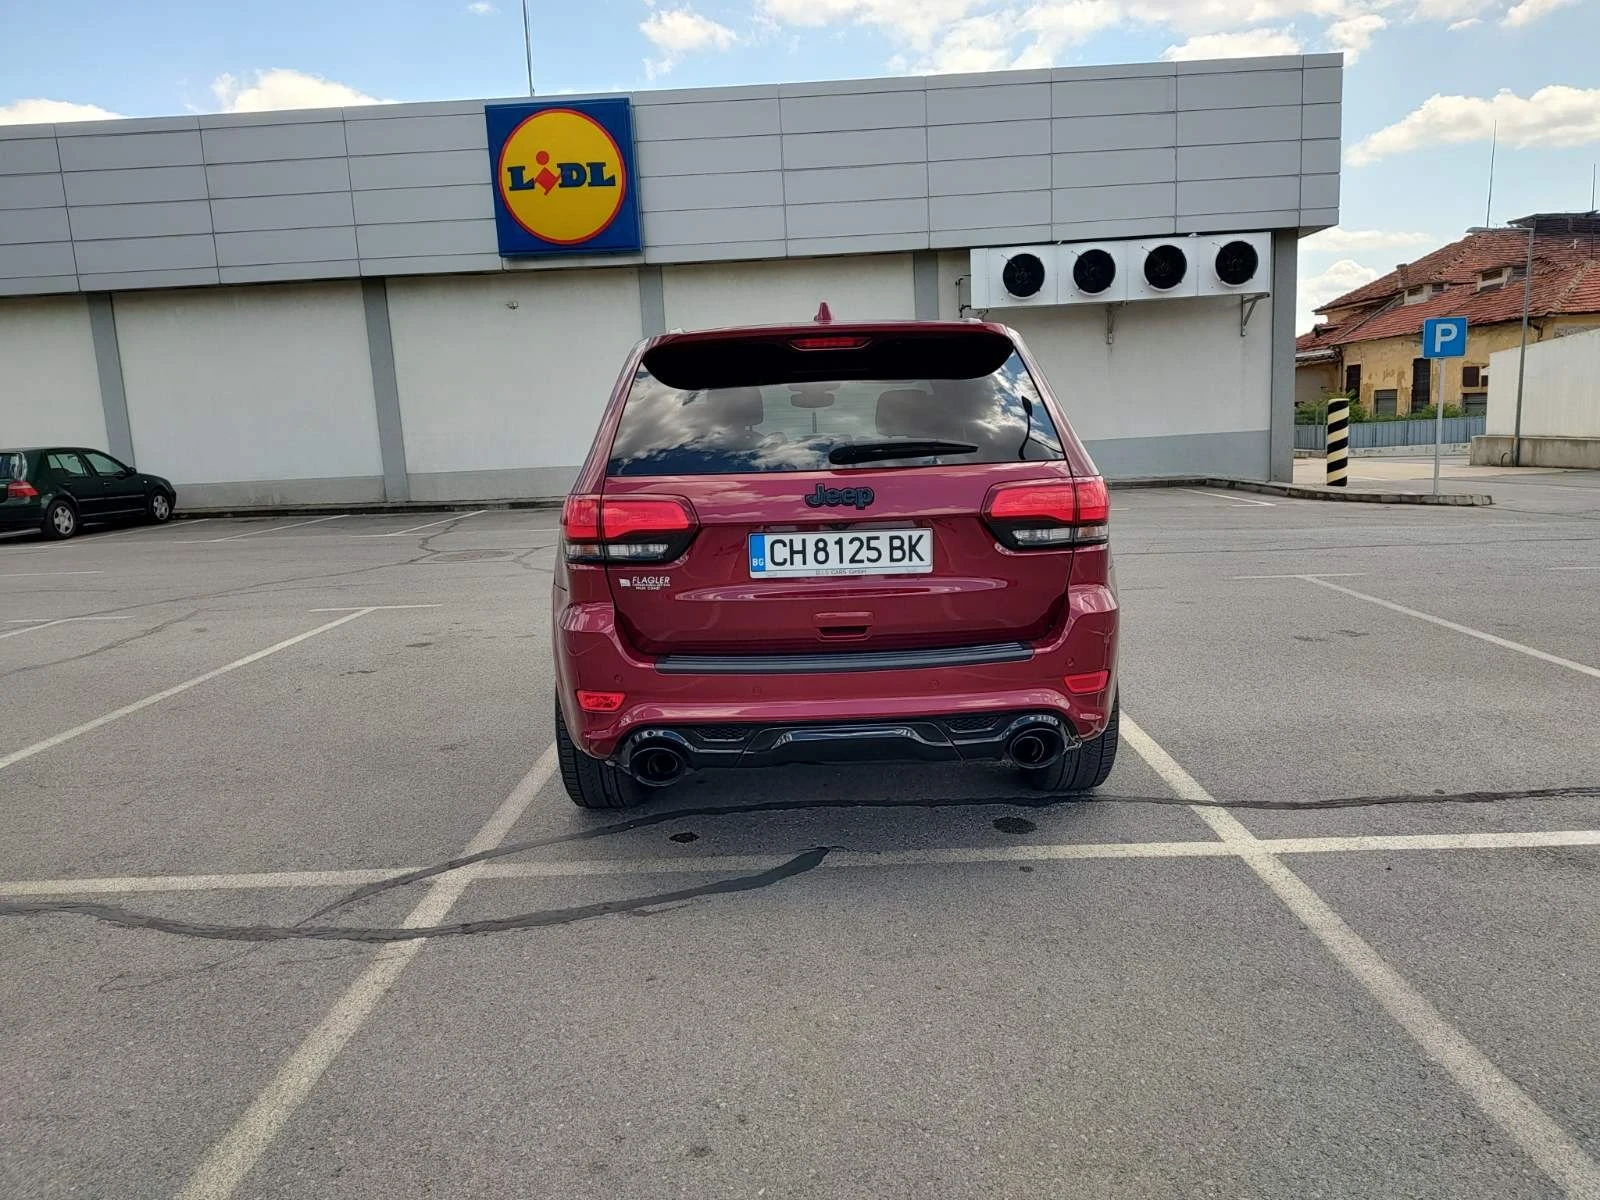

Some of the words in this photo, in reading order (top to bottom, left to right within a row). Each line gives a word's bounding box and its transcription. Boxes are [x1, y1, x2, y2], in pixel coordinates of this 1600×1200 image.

[1435, 323, 1457, 352] P
[805, 483, 874, 510] Jeep
[752, 558, 764, 566] BG
[770, 538, 807, 566] CH
[813, 536, 882, 564] 8125
[889, 534, 925, 563] BK
[632, 576, 670, 584] FLAGLER
